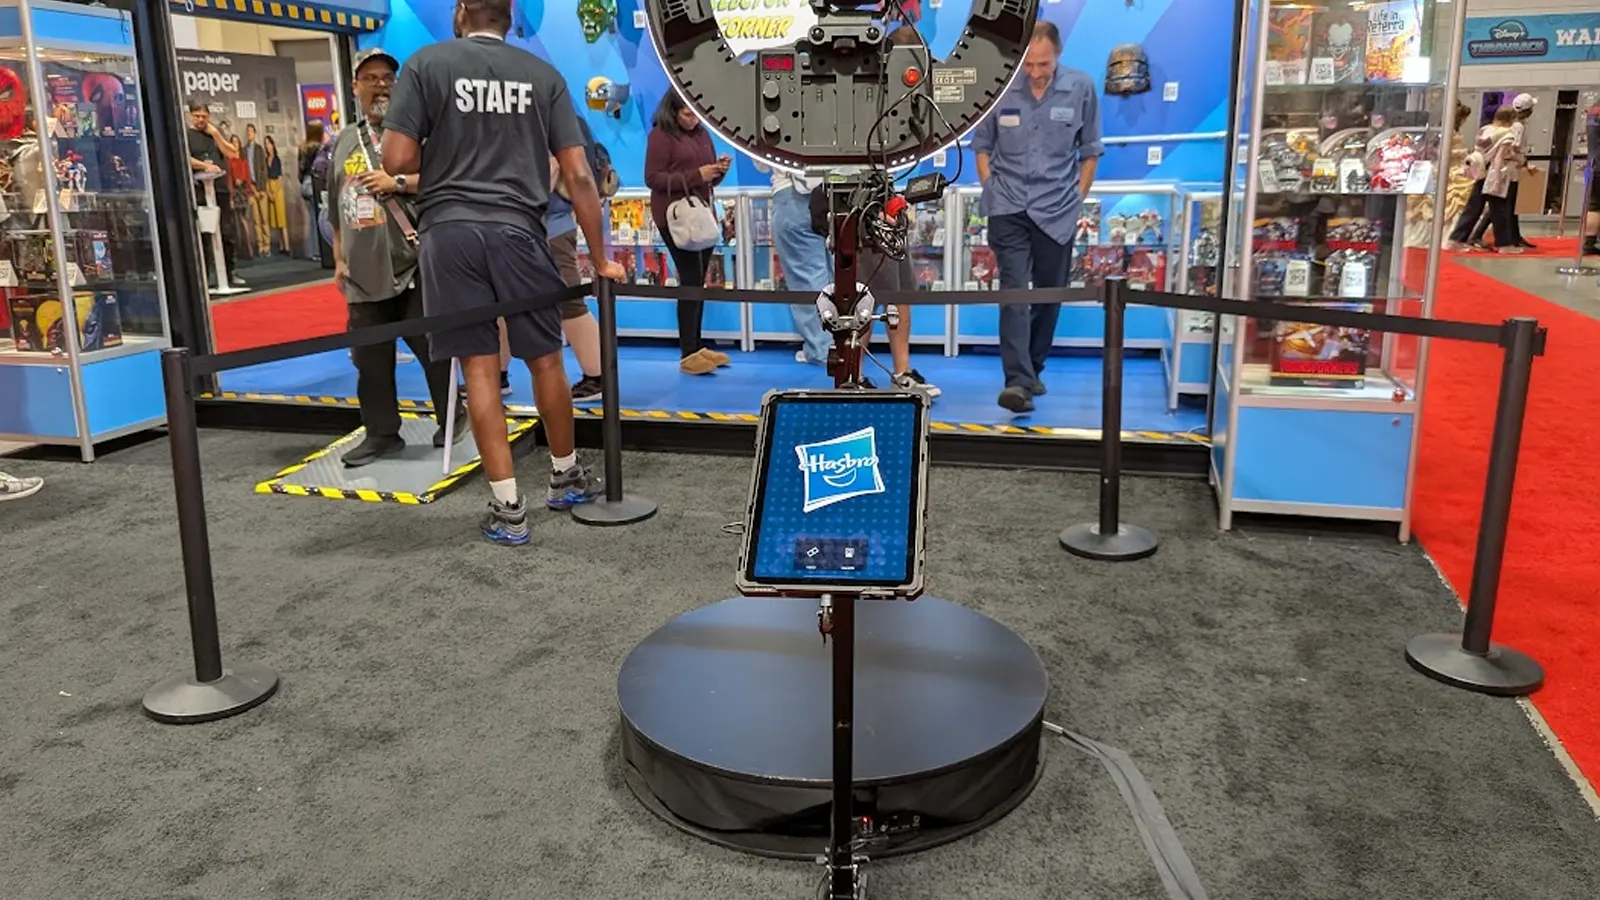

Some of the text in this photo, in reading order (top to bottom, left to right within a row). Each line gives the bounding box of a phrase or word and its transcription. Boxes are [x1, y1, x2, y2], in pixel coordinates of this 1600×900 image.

[1373, 9, 1398, 22] Life in
[183, 70, 240, 96] paper
[307, 97, 326, 110] LEGO
[455, 77, 533, 114] STAFF
[800, 452, 879, 475] Hasbro
